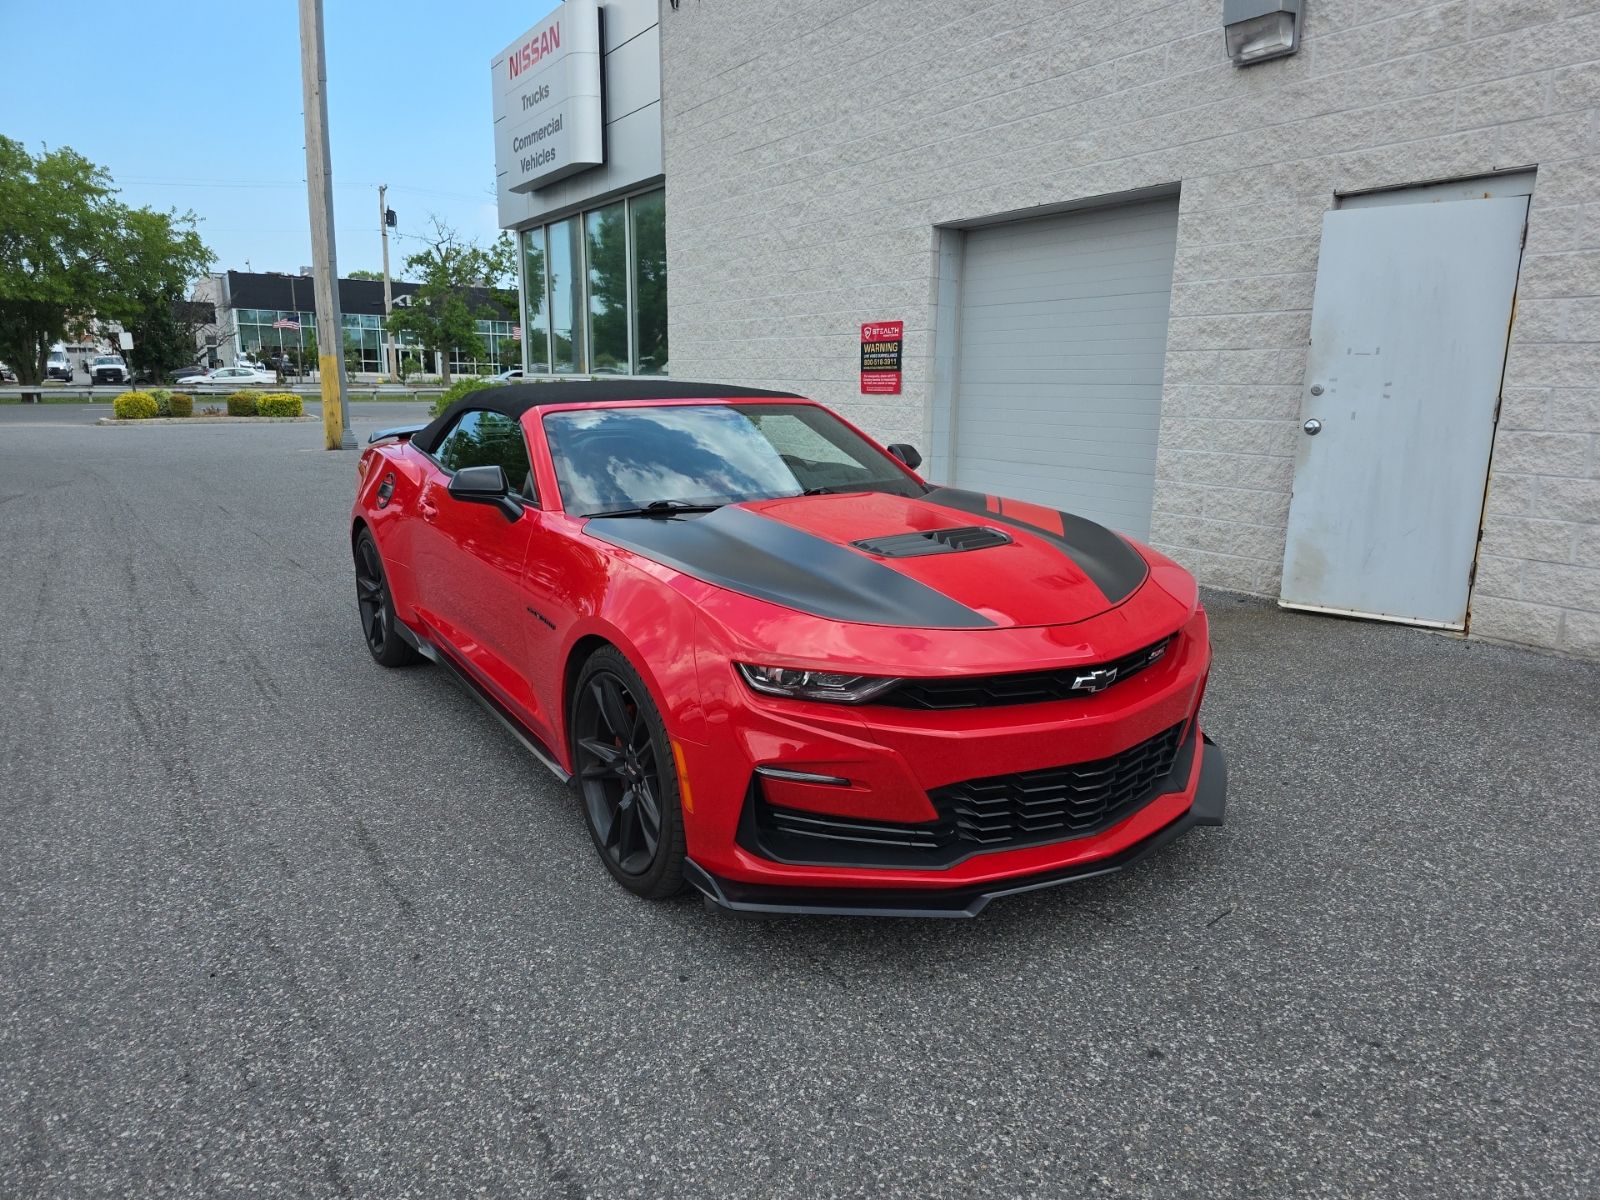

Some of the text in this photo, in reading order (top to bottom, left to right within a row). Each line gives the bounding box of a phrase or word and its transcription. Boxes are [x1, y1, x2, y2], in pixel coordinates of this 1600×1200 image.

[509, 22, 561, 80] NISSAN
[521, 84, 550, 111] Trucks
[513, 113, 563, 153] Commercial
[520, 147, 556, 174] Vehicles
[864, 343, 898, 353] WARNING
